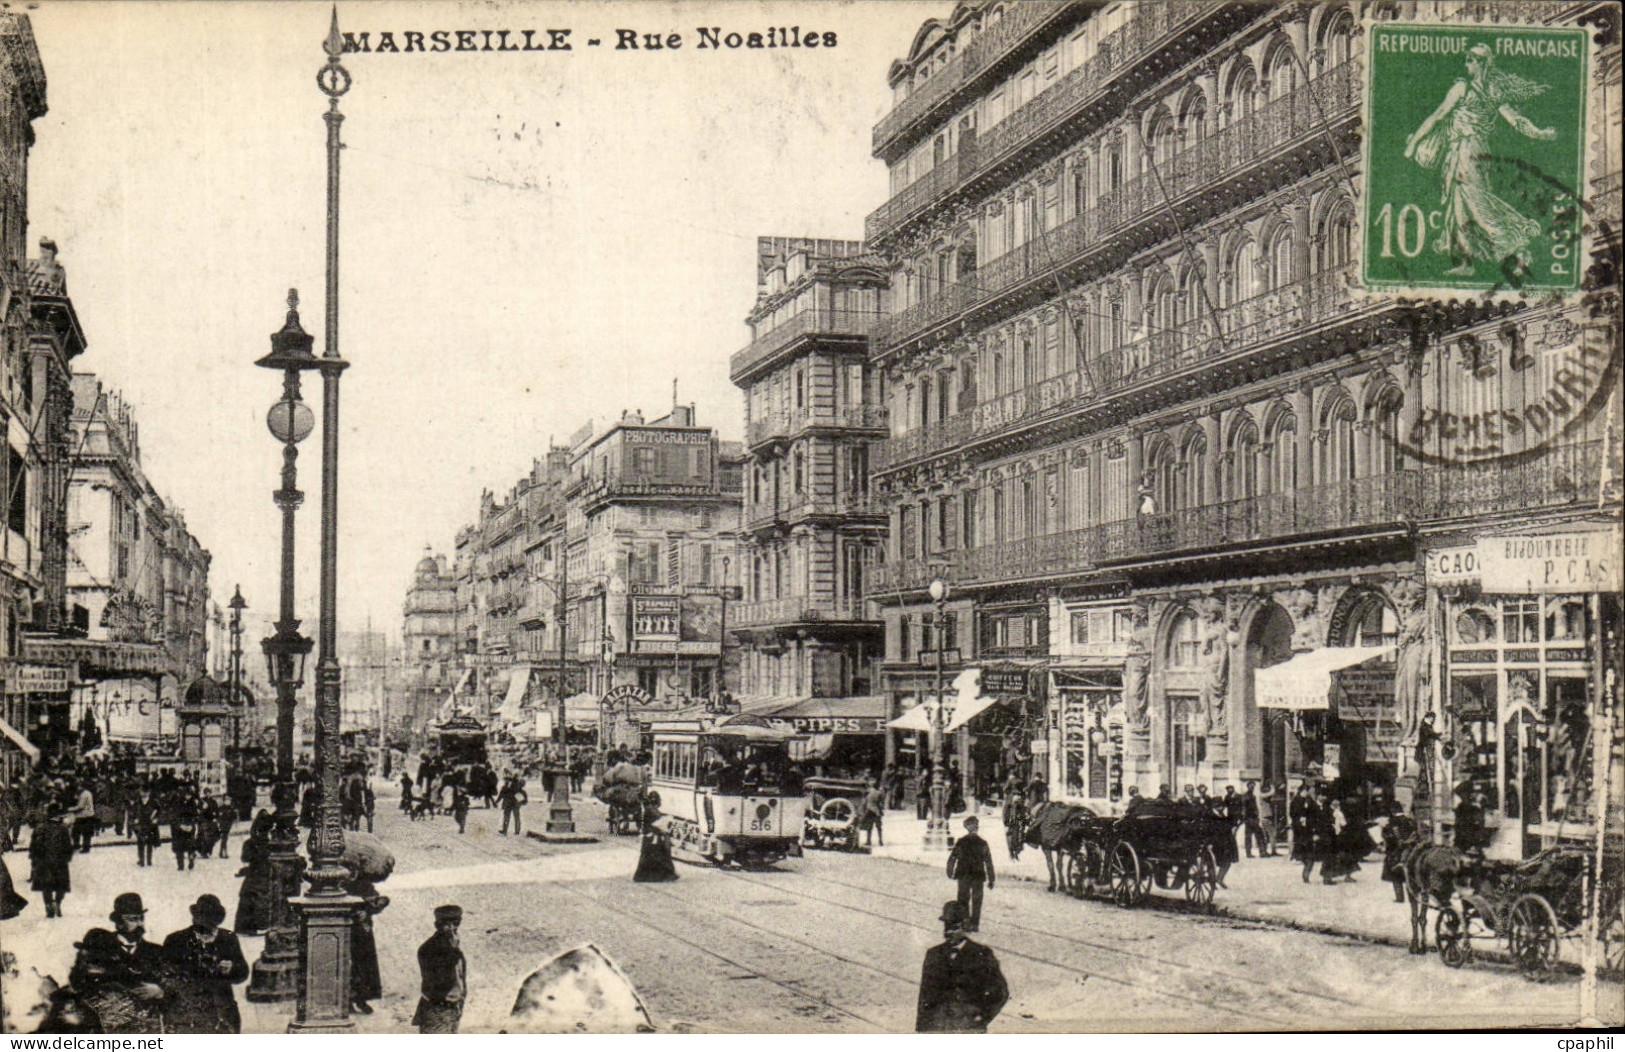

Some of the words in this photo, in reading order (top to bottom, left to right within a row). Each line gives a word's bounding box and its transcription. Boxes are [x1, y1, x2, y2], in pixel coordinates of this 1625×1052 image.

[1379, 33, 1469, 55] REPUBLIQUE
[1495, 36, 1579, 58] FRANÇAISE
[1550, 192, 1573, 275] POSES
[624, 429, 710, 445] PHOTOGRAPHIE
[1504, 537, 1590, 560] BIJOUTERIE
[1439, 552, 1481, 574] CAO
[1543, 560, 1560, 585] P.
[606, 685, 652, 704] ALCAZAR
[793, 717, 861, 733] PIPES
[750, 820, 772, 831] 516
